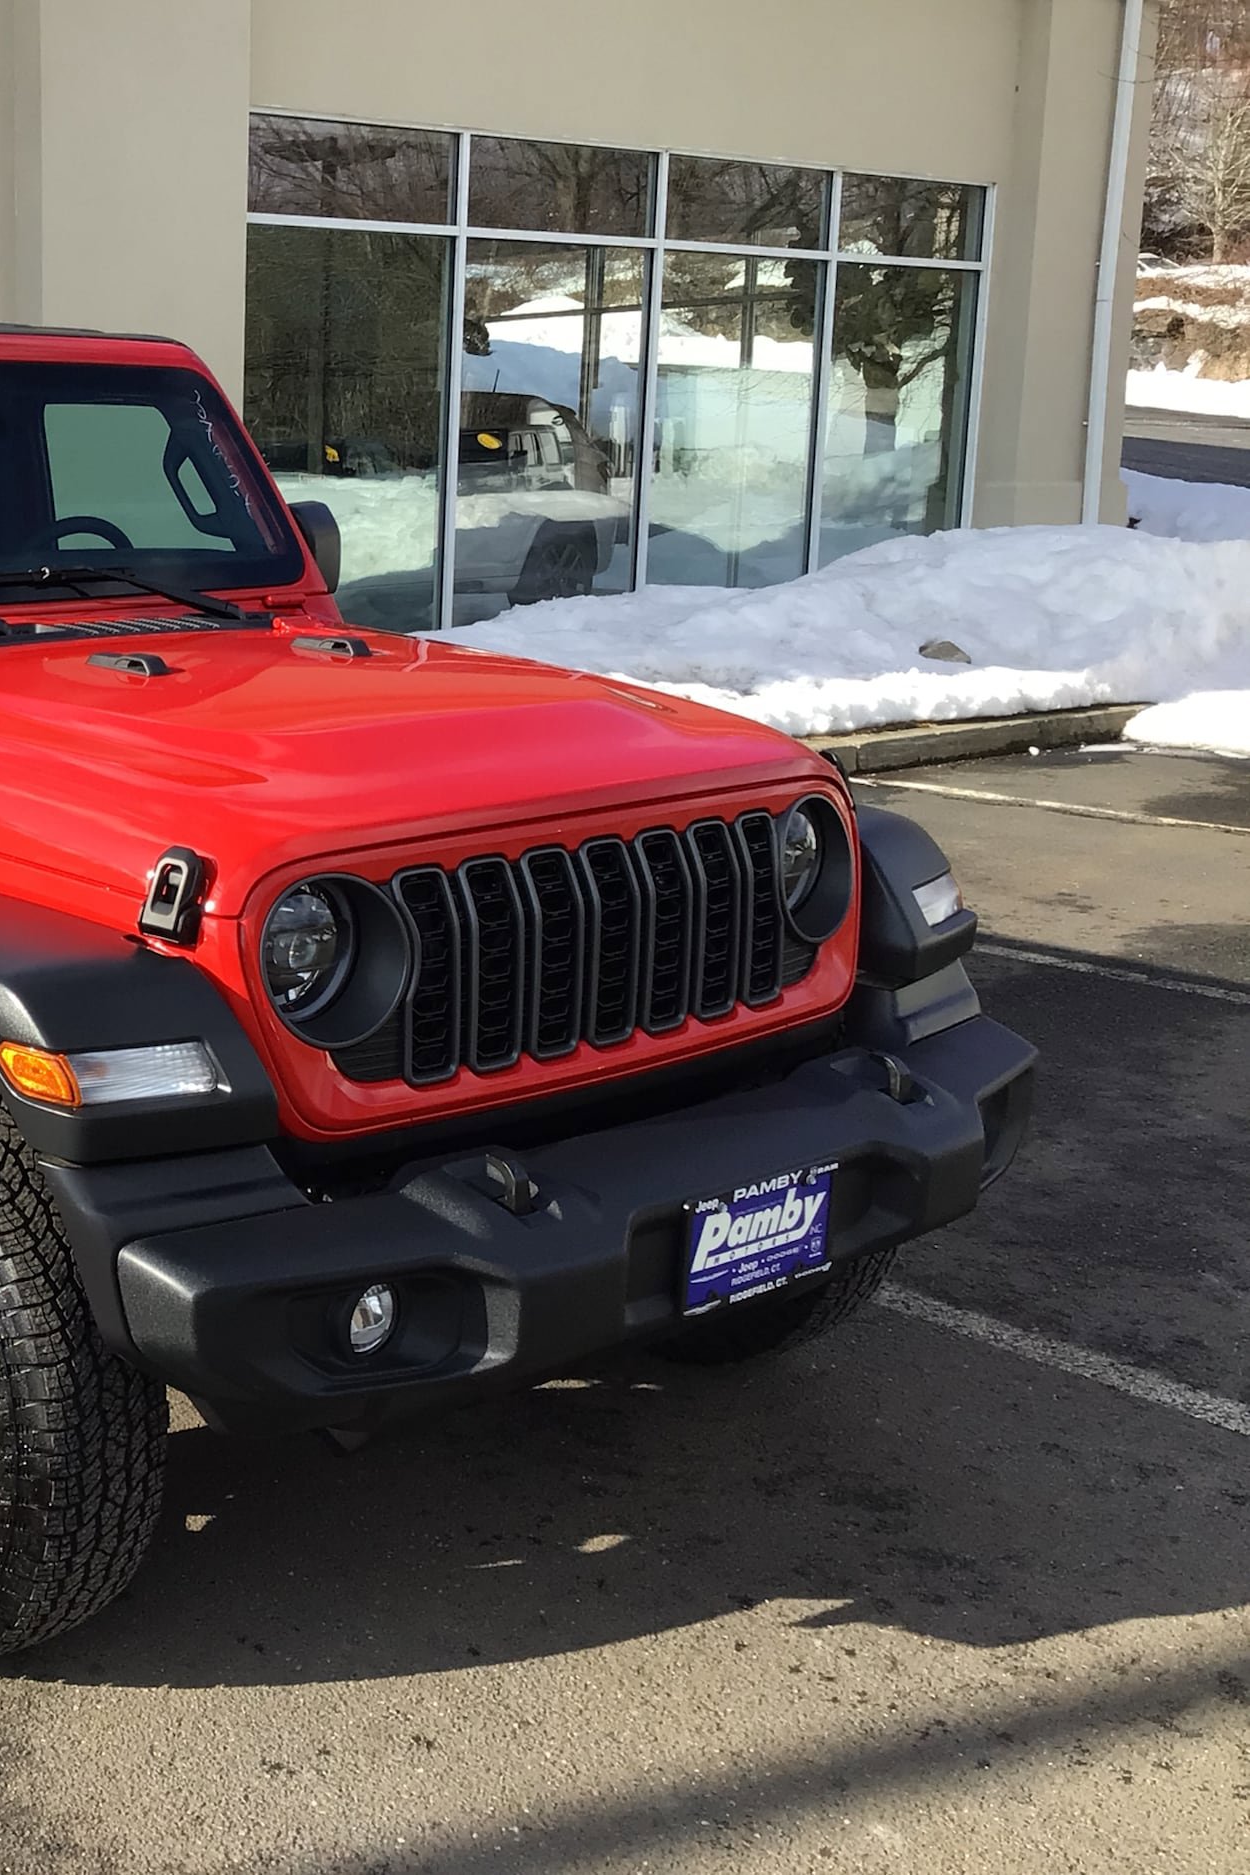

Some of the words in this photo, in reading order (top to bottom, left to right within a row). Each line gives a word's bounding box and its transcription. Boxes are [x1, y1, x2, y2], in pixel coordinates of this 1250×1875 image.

[817, 1162, 839, 1174] RAM
[733, 1170, 803, 1202] PAMBY
[695, 1198, 720, 1214] Jeep
[691, 1187, 827, 1274] Pamby
[738, 1260, 759, 1274] Jeep
